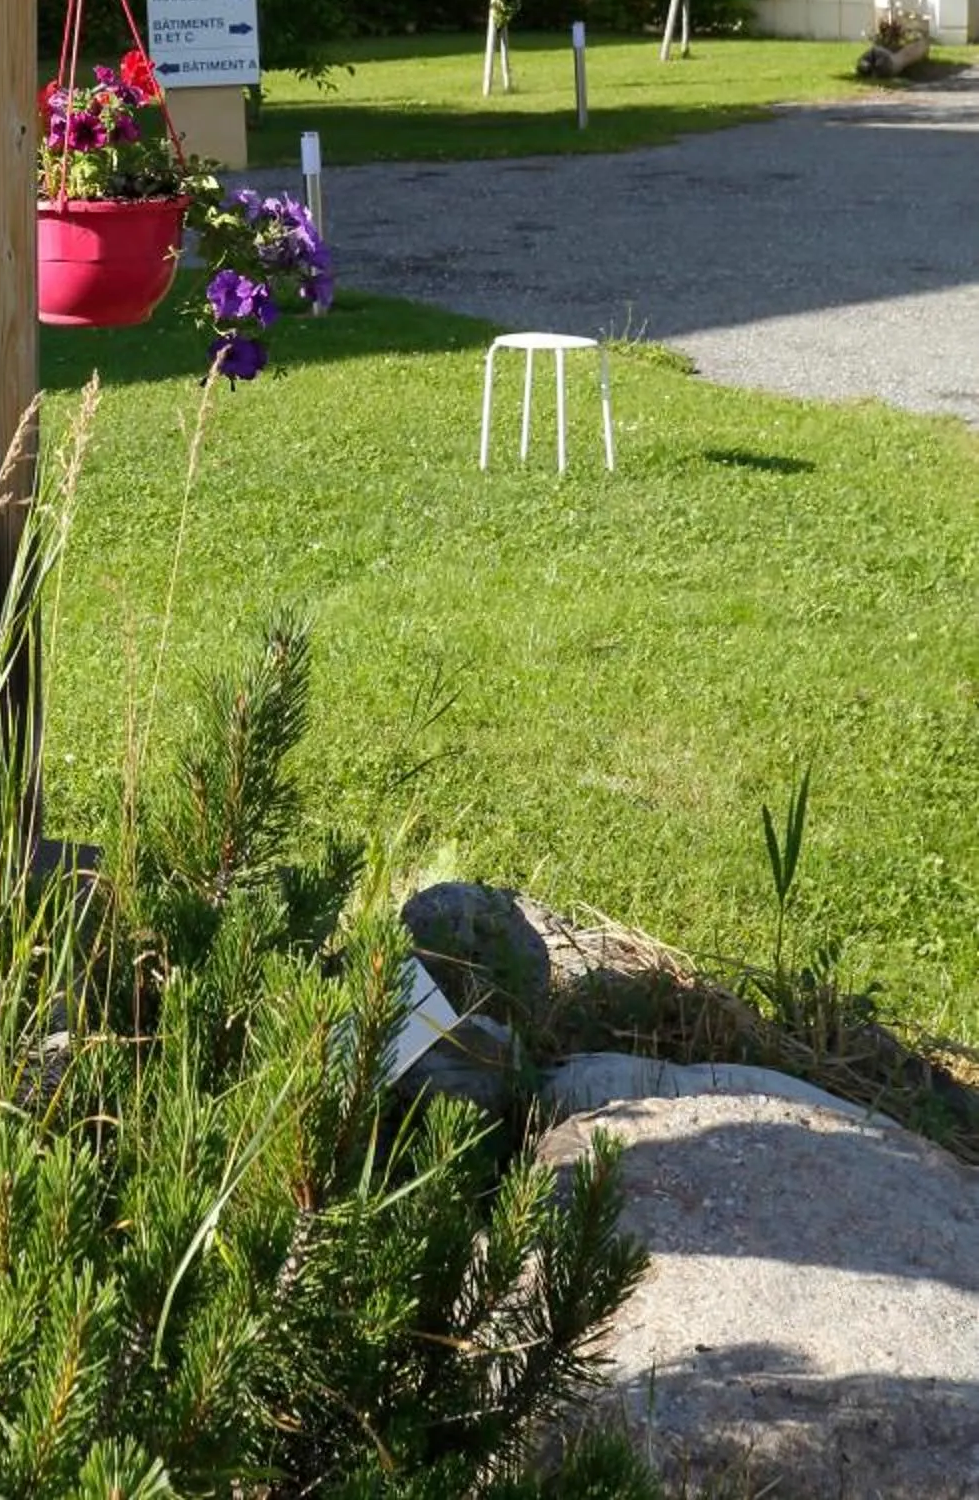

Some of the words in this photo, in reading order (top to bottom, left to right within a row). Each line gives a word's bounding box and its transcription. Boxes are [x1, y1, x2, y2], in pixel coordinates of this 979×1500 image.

[153, 33, 163, 45] B
[166, 32, 181, 43] ET
[184, 31, 196, 43] C
[248, 59, 257, 70] A
